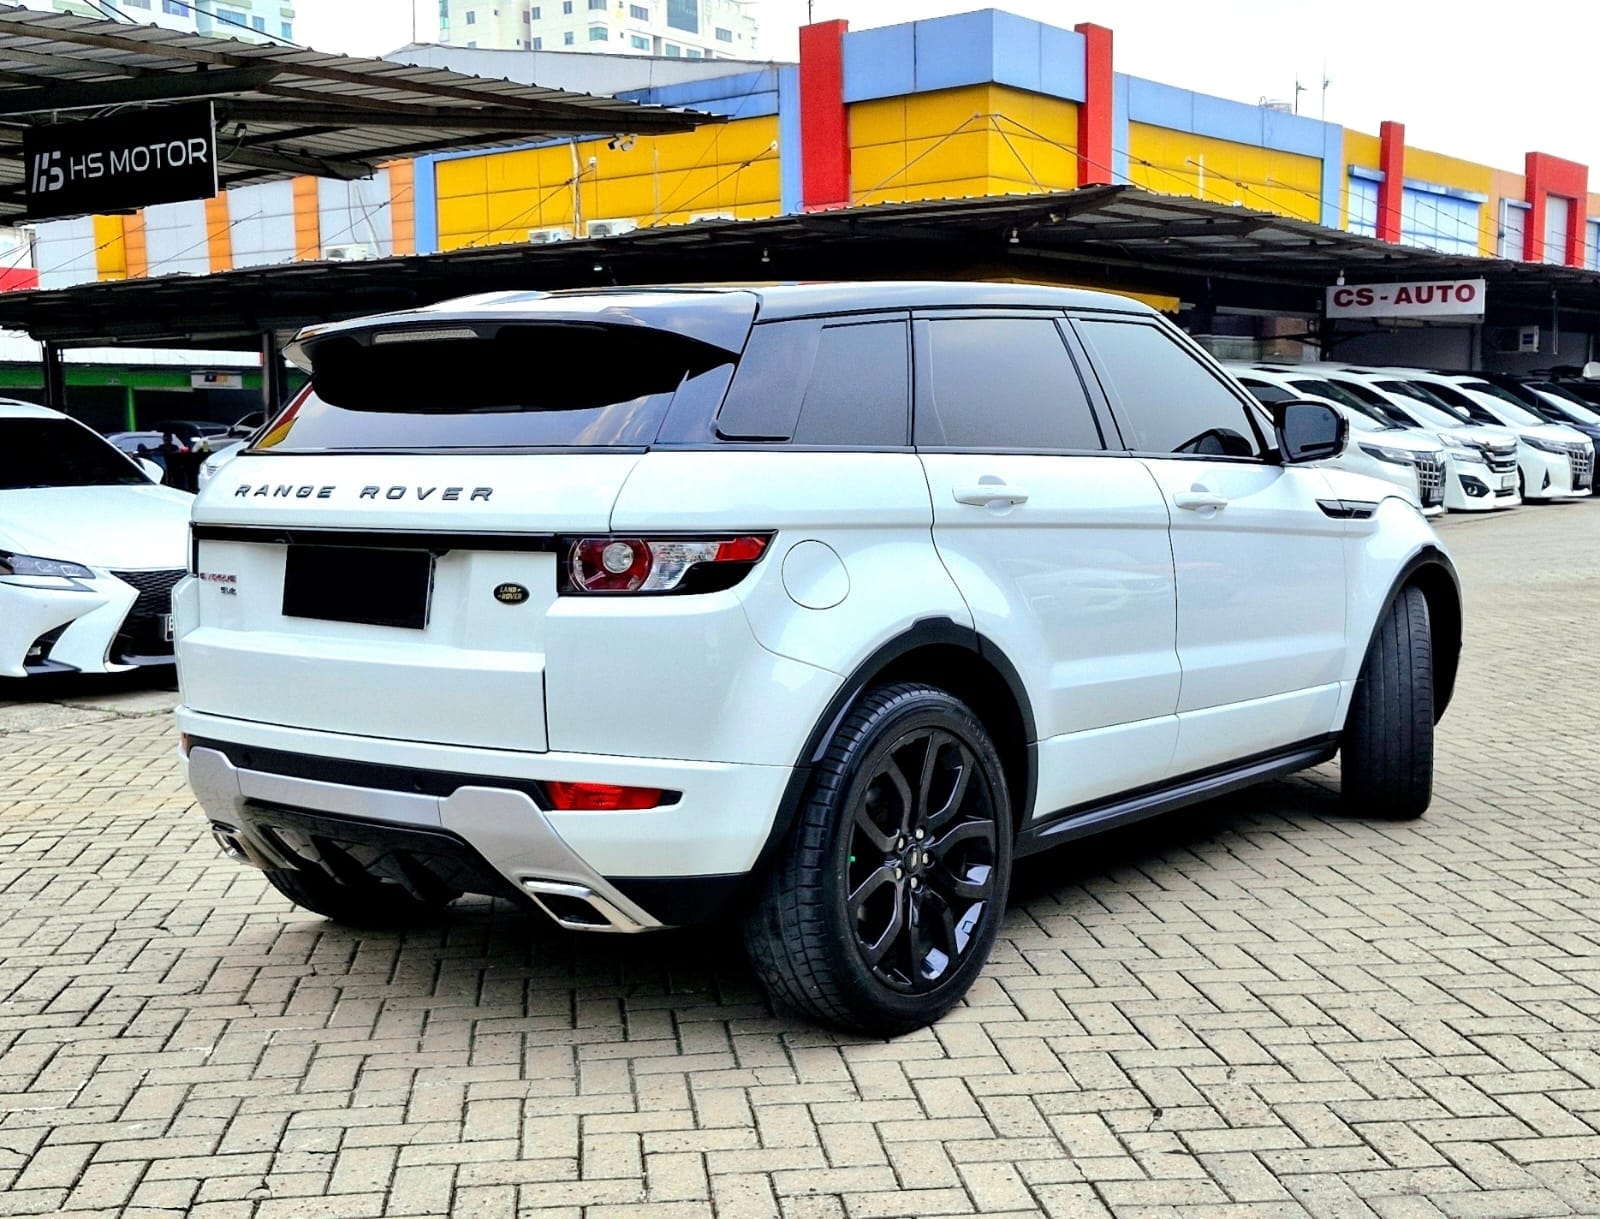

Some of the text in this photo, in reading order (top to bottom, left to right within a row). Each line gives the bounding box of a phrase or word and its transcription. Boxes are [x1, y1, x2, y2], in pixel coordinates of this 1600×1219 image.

[70, 138, 208, 180] HS MOTOR
[234, 483, 494, 501] RANGE ROVER
